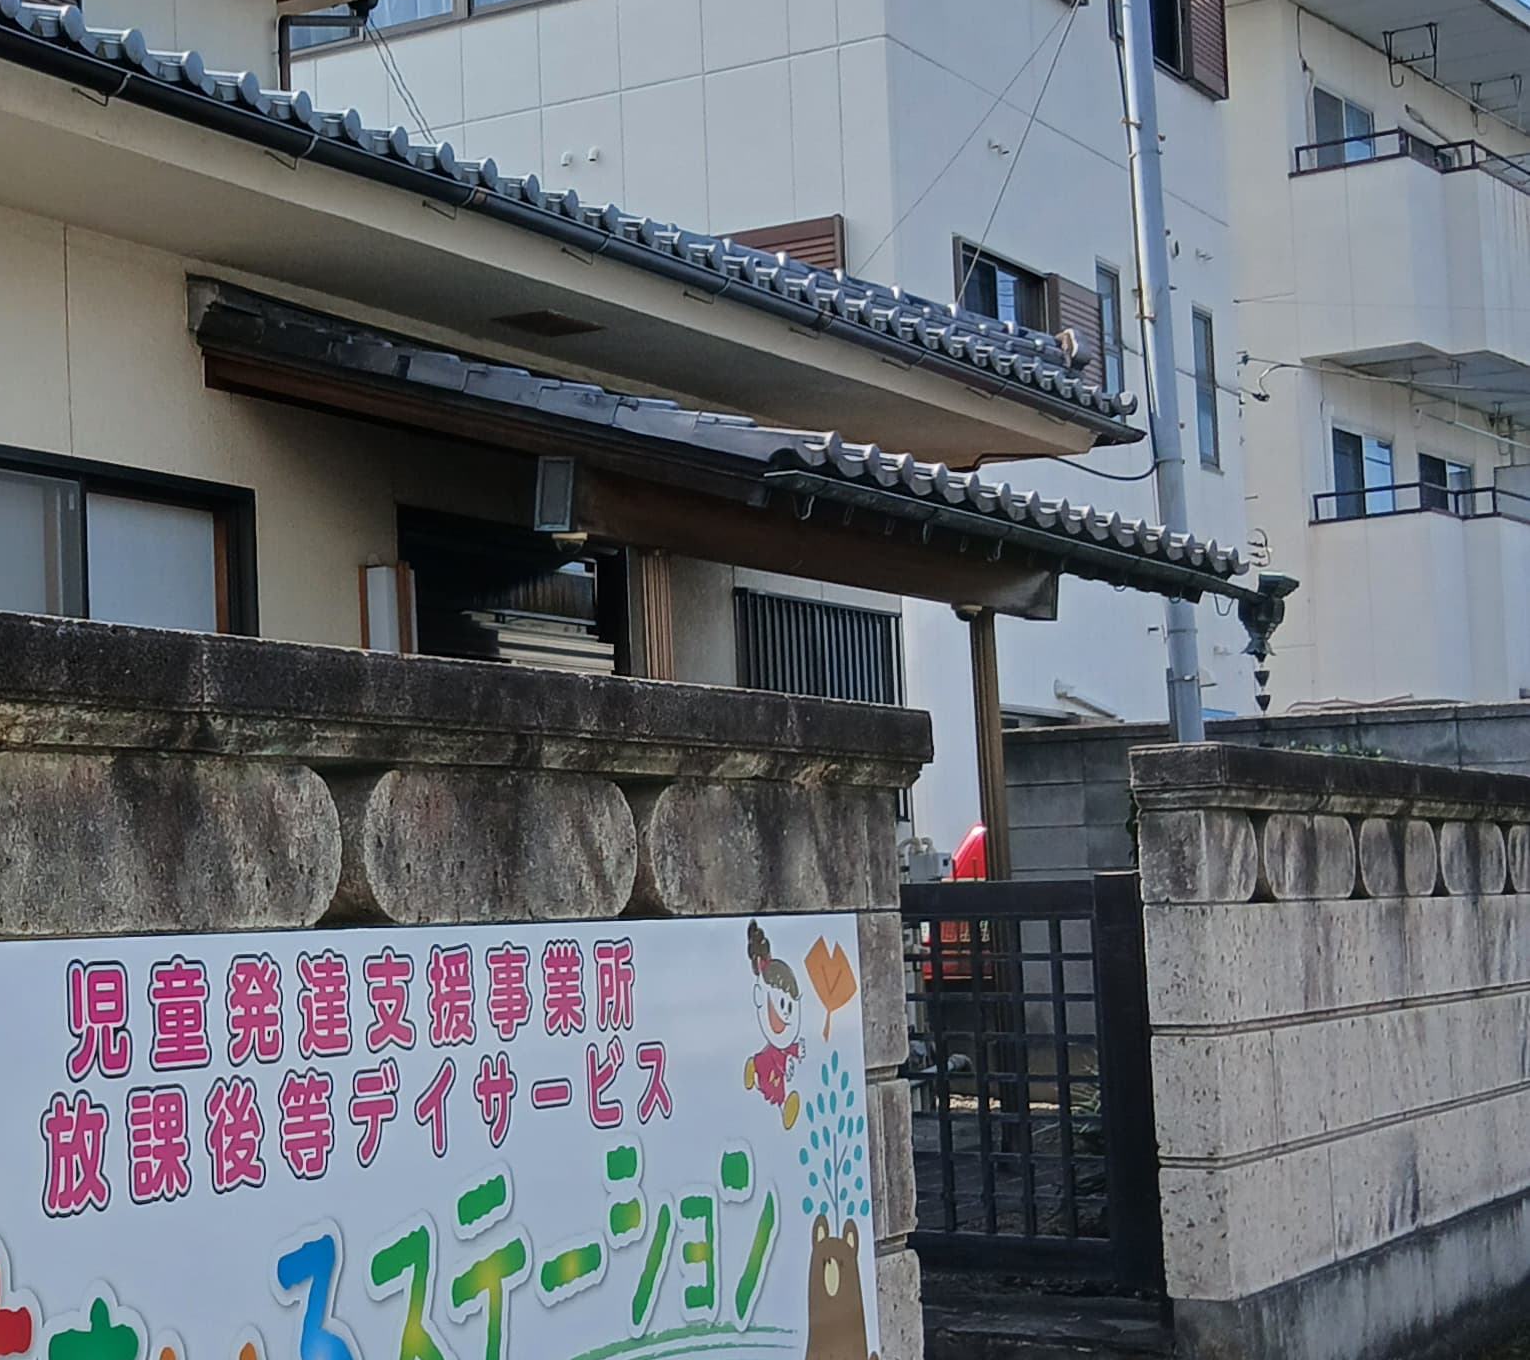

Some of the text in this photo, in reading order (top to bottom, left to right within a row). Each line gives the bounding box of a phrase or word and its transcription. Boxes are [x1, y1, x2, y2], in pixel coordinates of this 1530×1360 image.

[67, 937, 635, 1083] 児童発達支援事業所
[41, 1035, 673, 1217] 放課後等デイサービス
